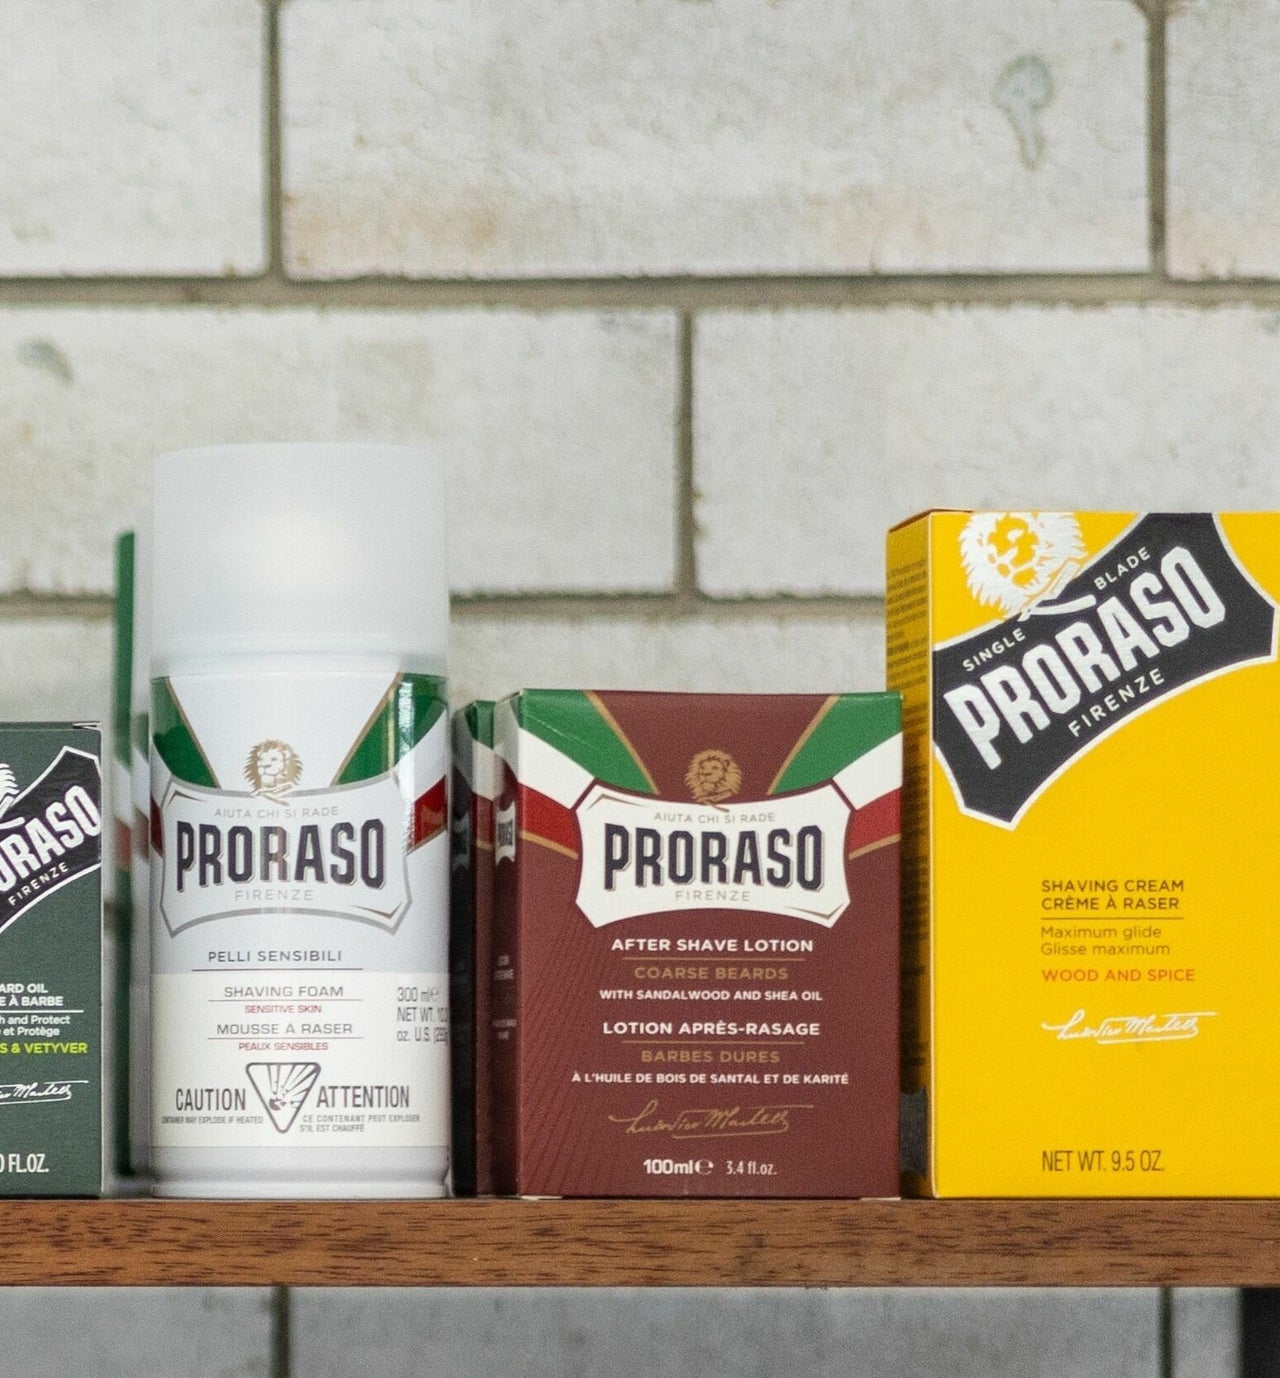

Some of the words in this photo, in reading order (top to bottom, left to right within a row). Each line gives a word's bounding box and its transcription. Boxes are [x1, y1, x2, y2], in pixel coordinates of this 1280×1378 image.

[1094, 546, 1151, 591] BLADE
[962, 628, 1025, 671] SINGLE
[944, 546, 1225, 770] PRORASO
[1068, 668, 1165, 737] FIRENZE
[177, 819, 386, 893] PRORASO
[604, 823, 826, 891] PRORASO
[1042, 880, 1119, 892] SHAVING
[1124, 880, 1184, 892] CREAM
[1042, 894, 1099, 910] CRÈME
[1106, 894, 1117, 910] À
[1123, 897, 1179, 910] RASER
[1041, 926, 1117, 938] Maximum
[1123, 925, 1161, 940] glide
[611, 939, 670, 951] AFTER
[677, 939, 738, 952] SHAVE
[744, 940, 813, 952] LOTION
[208, 951, 251, 962] PELLI
[258, 951, 342, 962] SENSIBILI
[635, 967, 709, 980] COARSE
[716, 968, 788, 980] BEARDS
[1042, 969, 1098, 981] WOOD
[1105, 969, 1141, 981] AND
[1148, 969, 1195, 981] SPICE
[224, 986, 292, 998] SHAVING
[299, 986, 343, 997] FOAM
[245, 1005, 294, 1013] SENSITIVE
[298, 1005, 322, 1013] SKIN
[603, 1022, 673, 1035] LOTION
[679, 1020, 820, 1035] APRÈS-RASAGE
[176, 1088, 246, 1111] CAUTION
[316, 1086, 410, 1108] ATTENTION
[1042, 1151, 1072, 1171] NET
[1078, 1151, 1106, 1171] WT.
[1112, 1151, 1134, 1171] 9.5
[1140, 1150, 1164, 1171] OZ.
